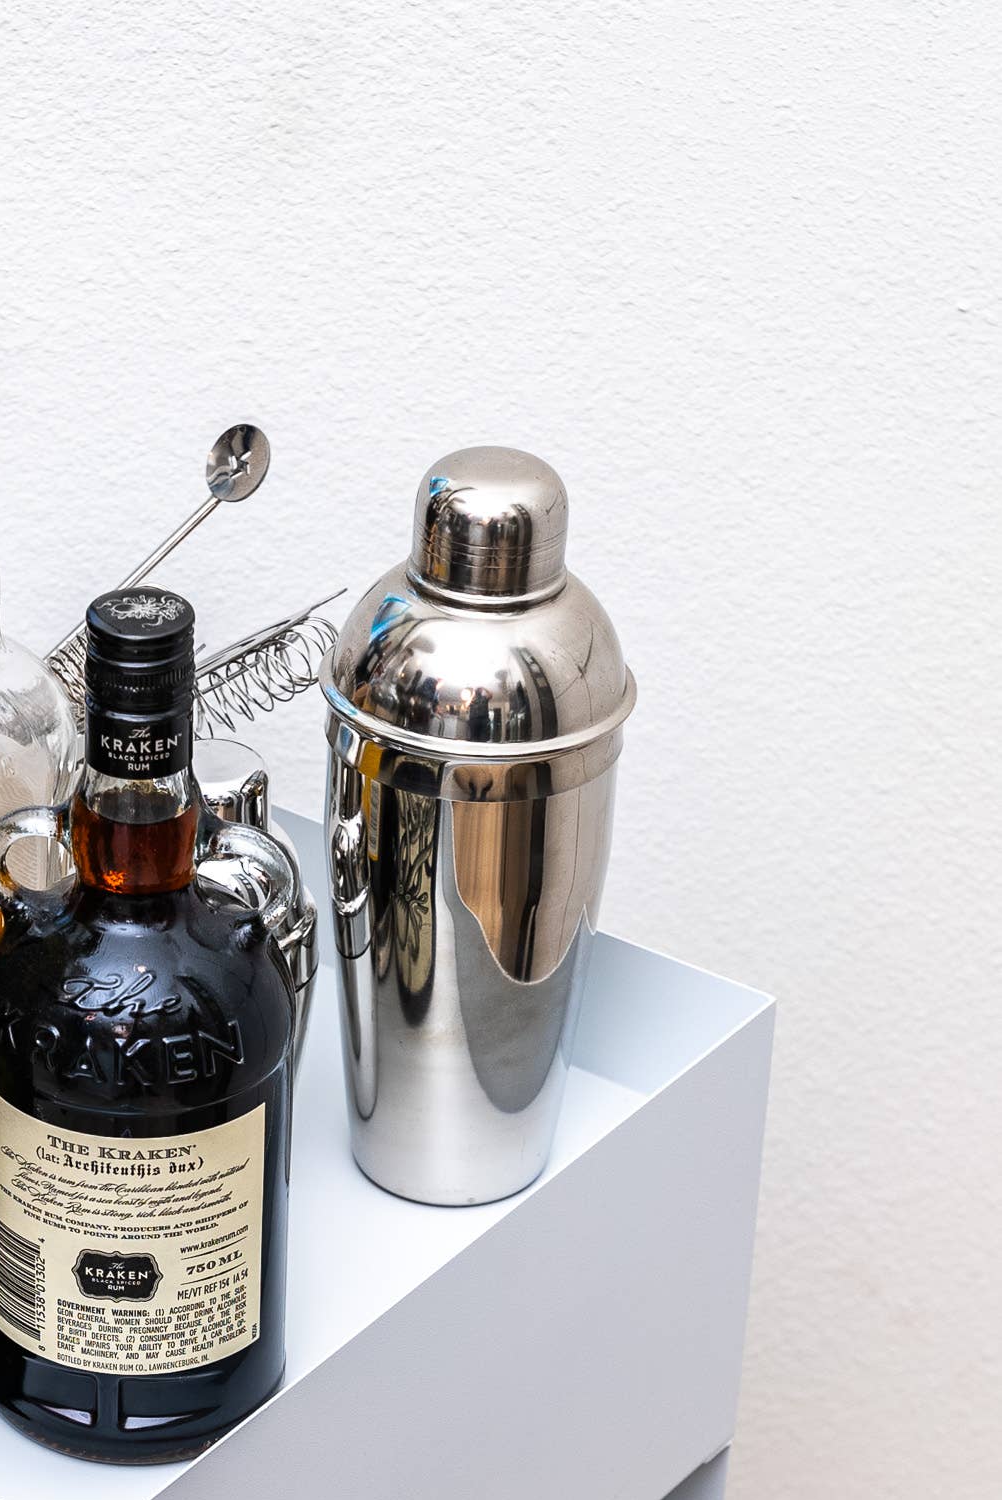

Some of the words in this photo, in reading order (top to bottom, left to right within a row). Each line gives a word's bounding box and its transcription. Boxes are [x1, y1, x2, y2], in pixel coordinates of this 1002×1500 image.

[128, 725, 150, 738] The
[108, 752, 135, 761] BLACK
[139, 752, 170, 761] SPICED
[127, 763, 150, 771] RUM
[63, 971, 182, 1017] The
[47, 1135, 89, 1156] THE
[36, 1146, 60, 1165] (lat:
[63, 1154, 160, 1178] Architeuthis
[169, 1156, 204, 1174] dux)
[0, 1183, 12, 1198] THE
[13, 1194, 42, 1214] KRAKEN
[44, 1210, 63, 1222] RUM
[114, 1225, 170, 1233] PRODUCERS
[173, 1221, 193, 1230] AND
[195, 1207, 237, 1224] SHIPPERS
[238, 1200, 248, 1210] OF
[23, 1208, 41, 1221] FINE
[43, 1218, 66, 1230] RUMS
[68, 1226, 81, 1234] TO
[83, 1230, 118, 1239] POINTS
[163, 1231, 183, 1239] THE
[185, 1222, 219, 1236] WORLD.
[180, 1225, 248, 1254] www.krakenrum.com
[36, 1257, 46, 1293] 01302
[85, 1266, 148, 1280] KRAKEN
[186, 1260, 216, 1275] 750
[218, 1250, 243, 1267] ML
[57, 1298, 106, 1315] GOVERNMENT
[111, 1308, 150, 1317] WARNING:
[169, 1301, 205, 1315] ACCORDING
[209, 1297, 217, 1306] TO
[221, 1291, 231, 1301] THE
[234, 1284, 247, 1296] SUR-
[177, 1286, 202, 1301] ME/VT
[204, 1283, 218, 1295] REF
[233, 1273, 240, 1284] IA
[36, 1296, 46, 1330] 11538
[57, 1307, 74, 1318] GEON
[114, 1318, 140, 1326] WOMEN
[145, 1317, 172, 1325] SHOULD
[177, 1313, 190, 1322] NOT
[194, 1307, 214, 1319] DRINK
[217, 1292, 247, 1311] ALCOHOLIC
[57, 1315, 92, 1330] BEVERAGES
[98, 1325, 123, 1334] DURING
[129, 1325, 168, 1334] PREGNANCY
[174, 1319, 202, 1331] BECAUSE
[207, 1314, 216, 1323] OF
[220, 1309, 231, 1318] THE
[235, 1300, 247, 1311] RISK
[57, 1324, 65, 1332] OF
[68, 1328, 87, 1338] BIRTH
[91, 1332, 120, 1342] DEFECTS.
[139, 1331, 185, 1343] CONSUMPTION
[189, 1328, 198, 1337] OF
[201, 1317, 231, 1333] ALCOHOLIC
[57, 1332, 81, 1345] ERAGES
[84, 1339, 110, 1350] IMPAIRS
[138, 1343, 162, 1351] ABILITY
[167, 1340, 176, 1349] TO
[180, 1336, 198, 1347] DRIVE
[202, 1333, 207, 1342] A
[210, 1328, 222, 1339] CAR
[225, 1324, 234, 1333] OR
[57, 1340, 76, 1352] ERATE
[125, 1352, 140, 1360] AND
[145, 1351, 160, 1360] MAY
[165, 1347, 186, 1358] CAUSE
[192, 1340, 214, 1353] HEALTH
[57, 1352, 82, 1366] BOTTLED
[83, 1359, 91, 1367] BY
[92, 1361, 118, 1371] KRAKEN
[119, 1364, 134, 1372] RUM
